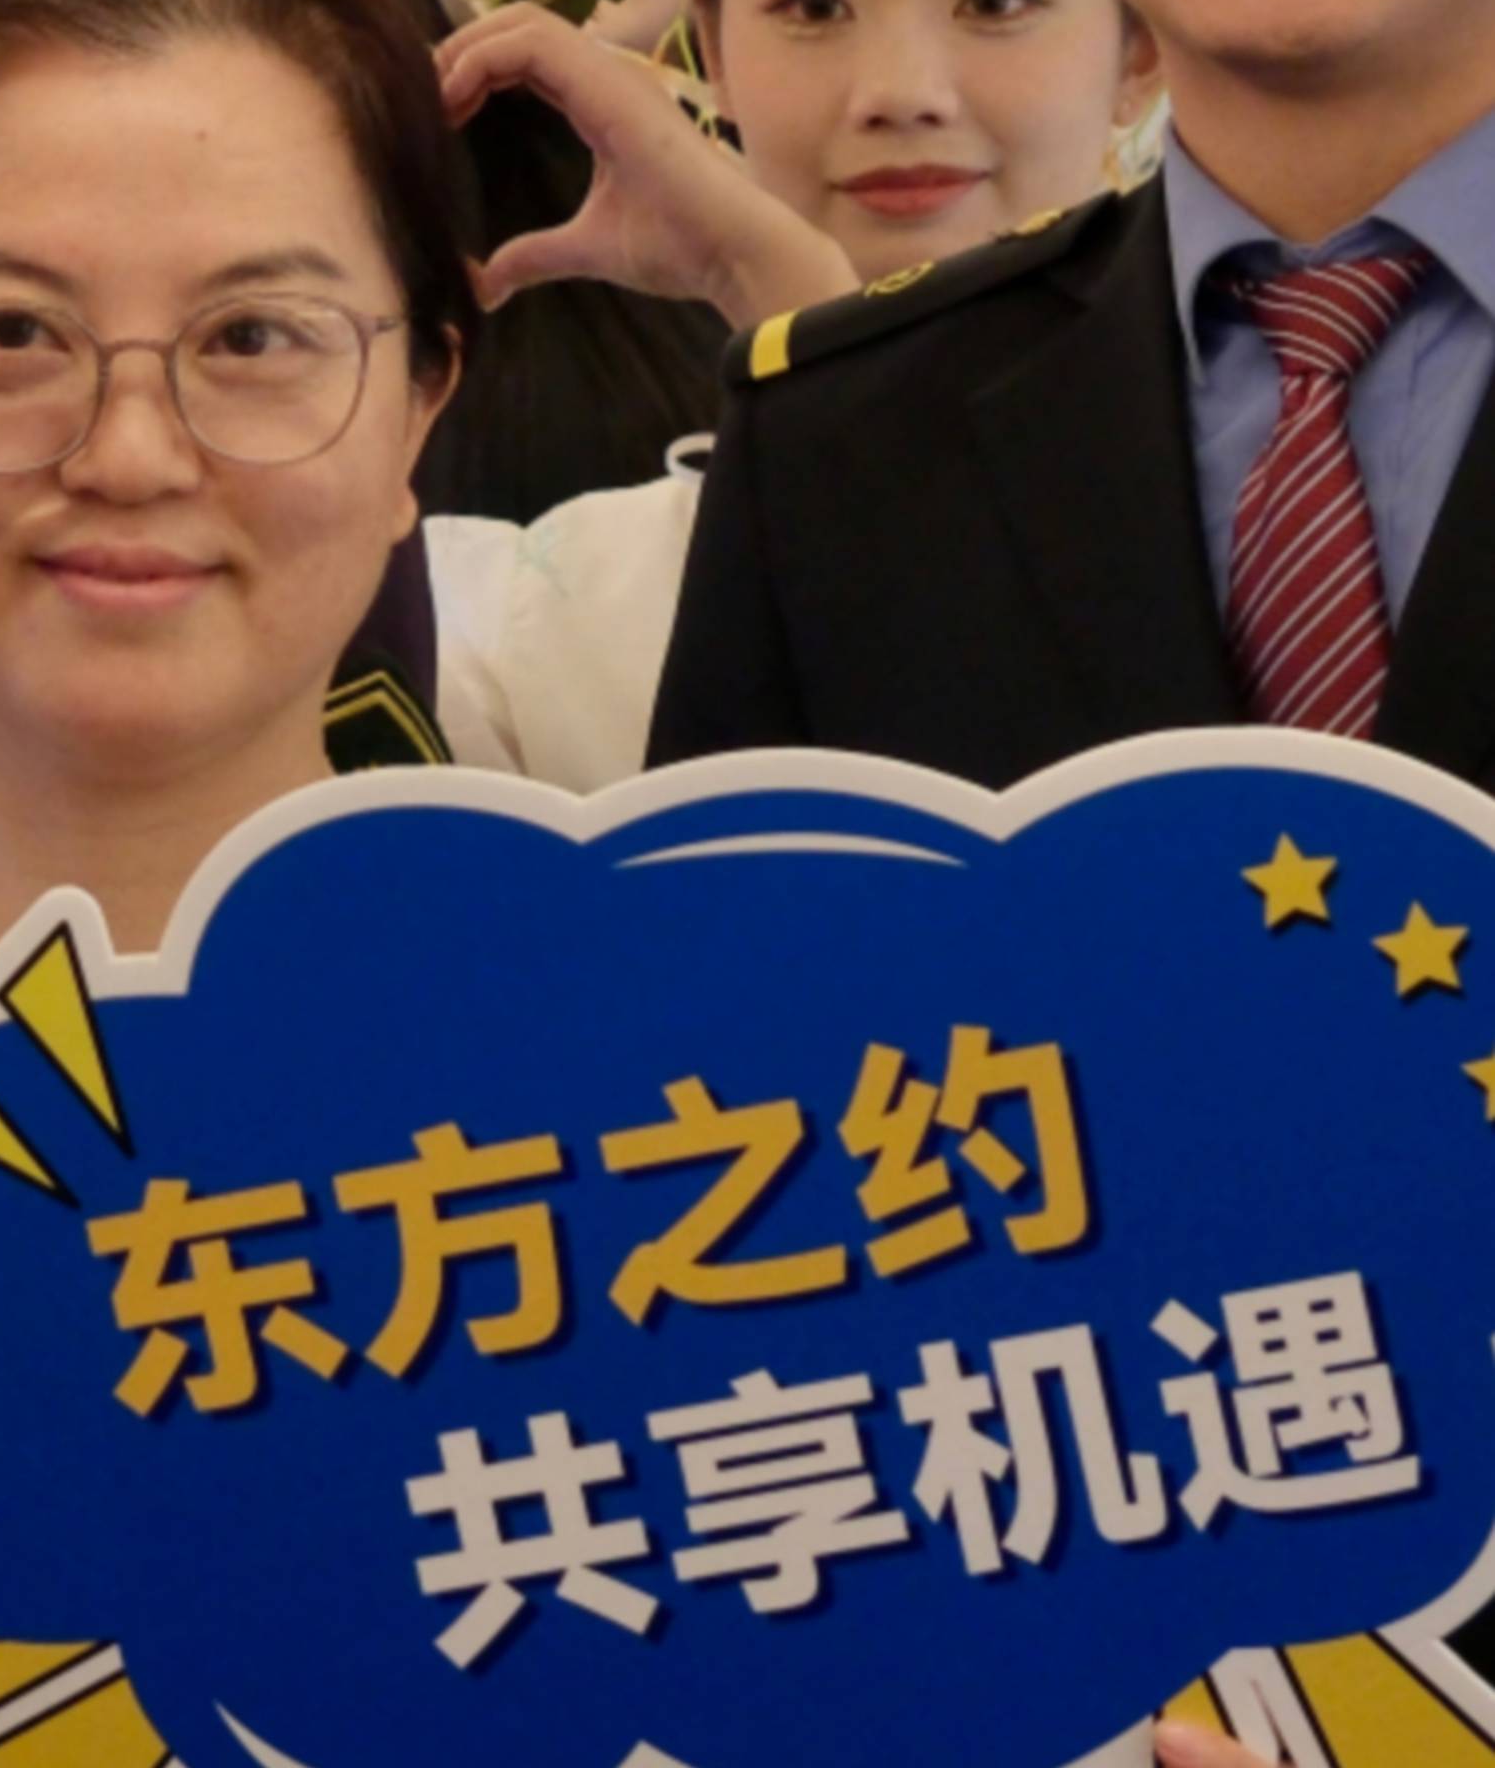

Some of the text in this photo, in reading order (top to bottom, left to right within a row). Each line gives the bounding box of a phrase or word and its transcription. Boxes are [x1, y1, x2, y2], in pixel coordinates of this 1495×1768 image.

[86, 1024, 1093, 1416] 东方之约
[405, 1270, 1422, 1672] 共享机遇
